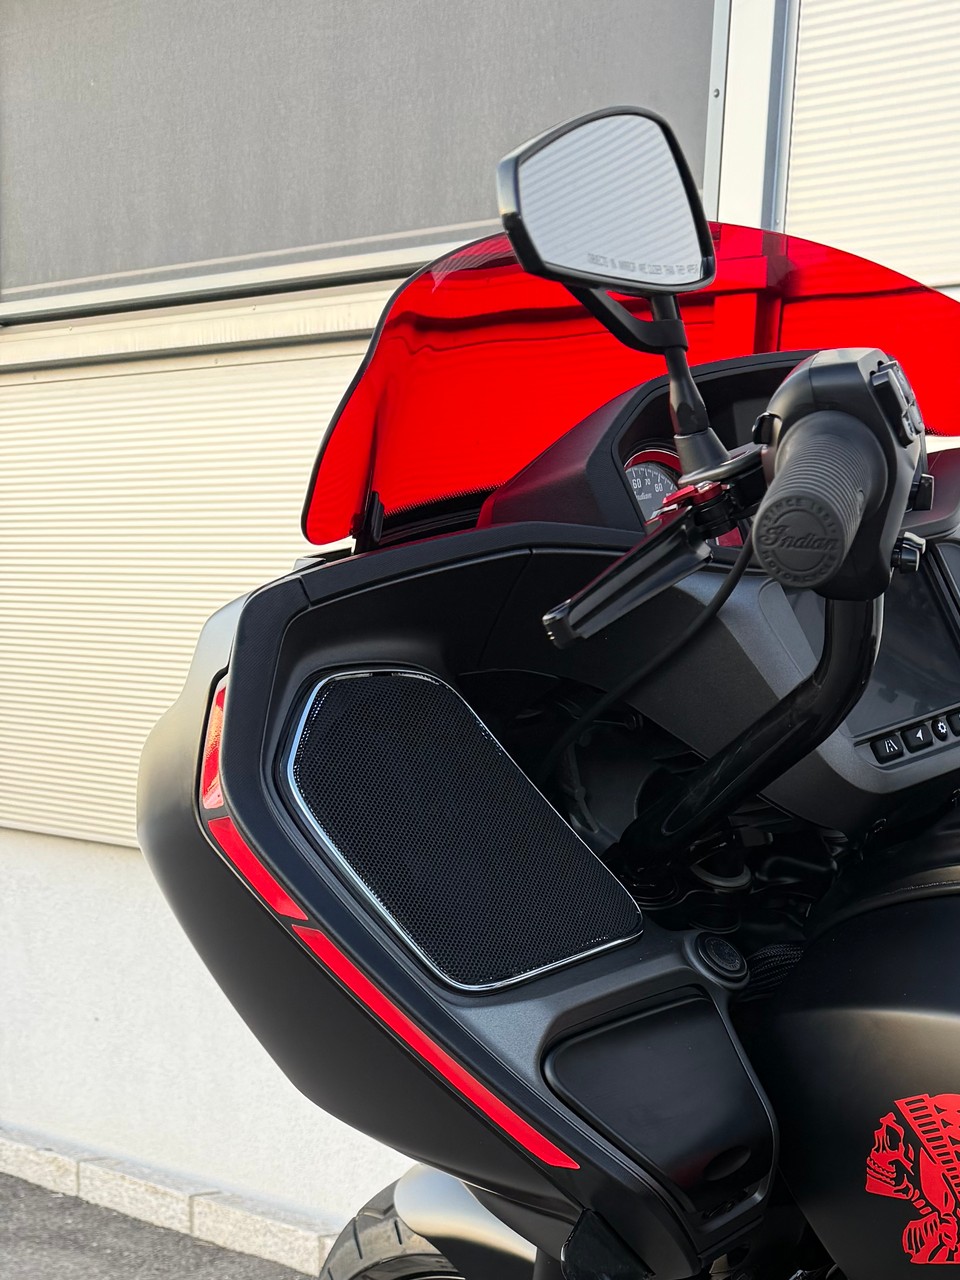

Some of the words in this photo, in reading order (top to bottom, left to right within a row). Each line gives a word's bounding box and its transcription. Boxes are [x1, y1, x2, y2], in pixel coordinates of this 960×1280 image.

[632, 479, 642, 488] 60
[654, 483, 663, 492] 80
[759, 525, 840, 553] Indian
